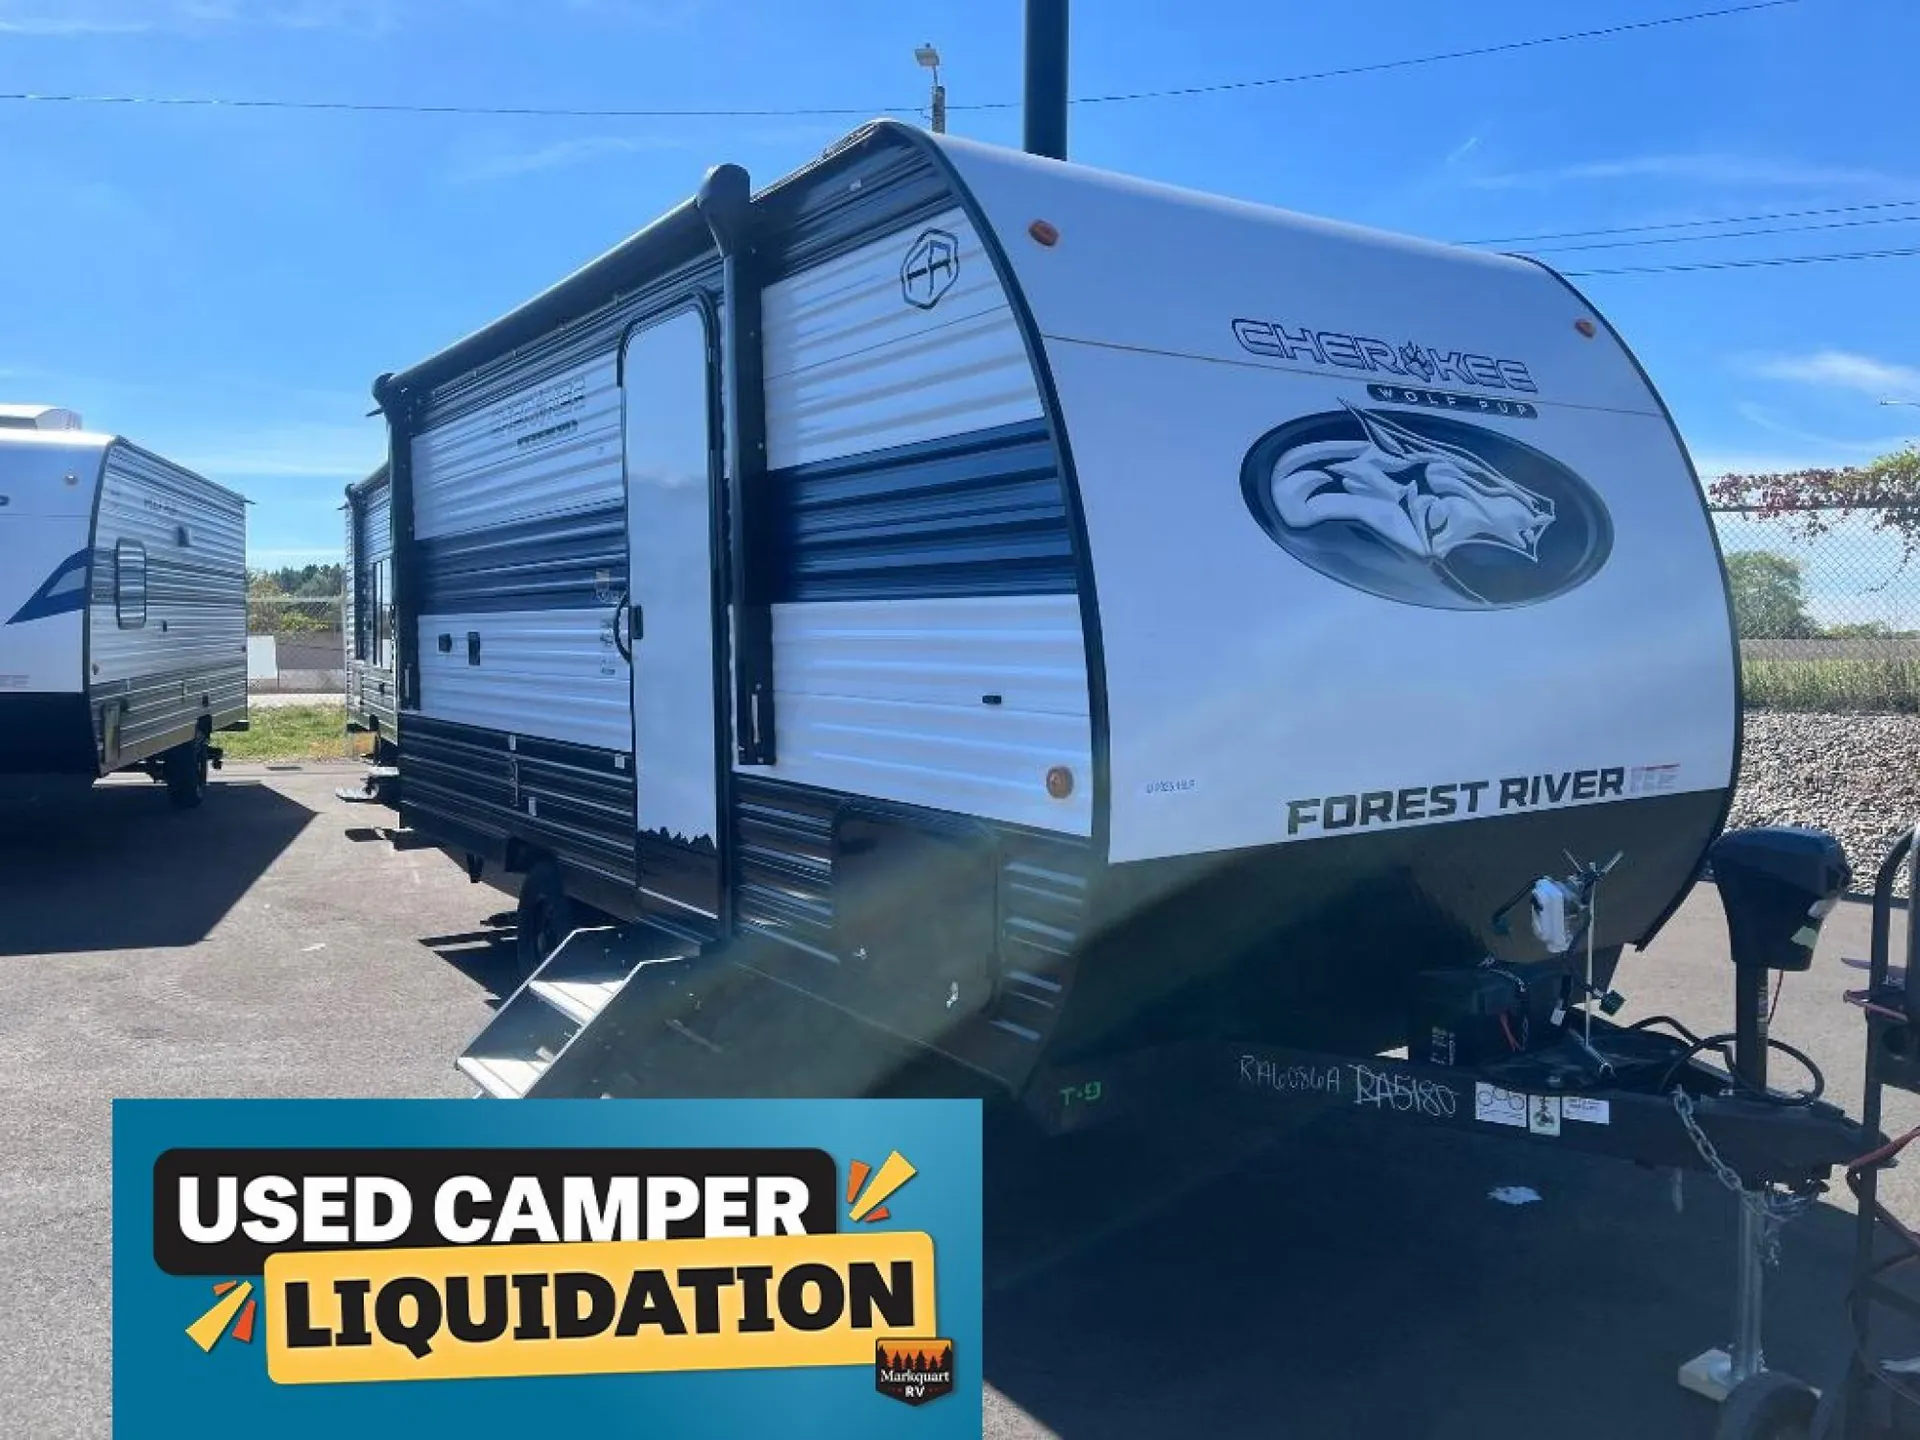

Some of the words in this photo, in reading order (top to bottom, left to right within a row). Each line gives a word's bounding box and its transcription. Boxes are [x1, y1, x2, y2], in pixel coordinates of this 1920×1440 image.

[1231, 317, 1538, 394] CHEROKEE
[1378, 386, 1457, 407] WOLF
[1478, 399, 1528, 416] PUP
[1287, 780, 1490, 835] FOREST
[1498, 766, 1625, 809] RIVER
